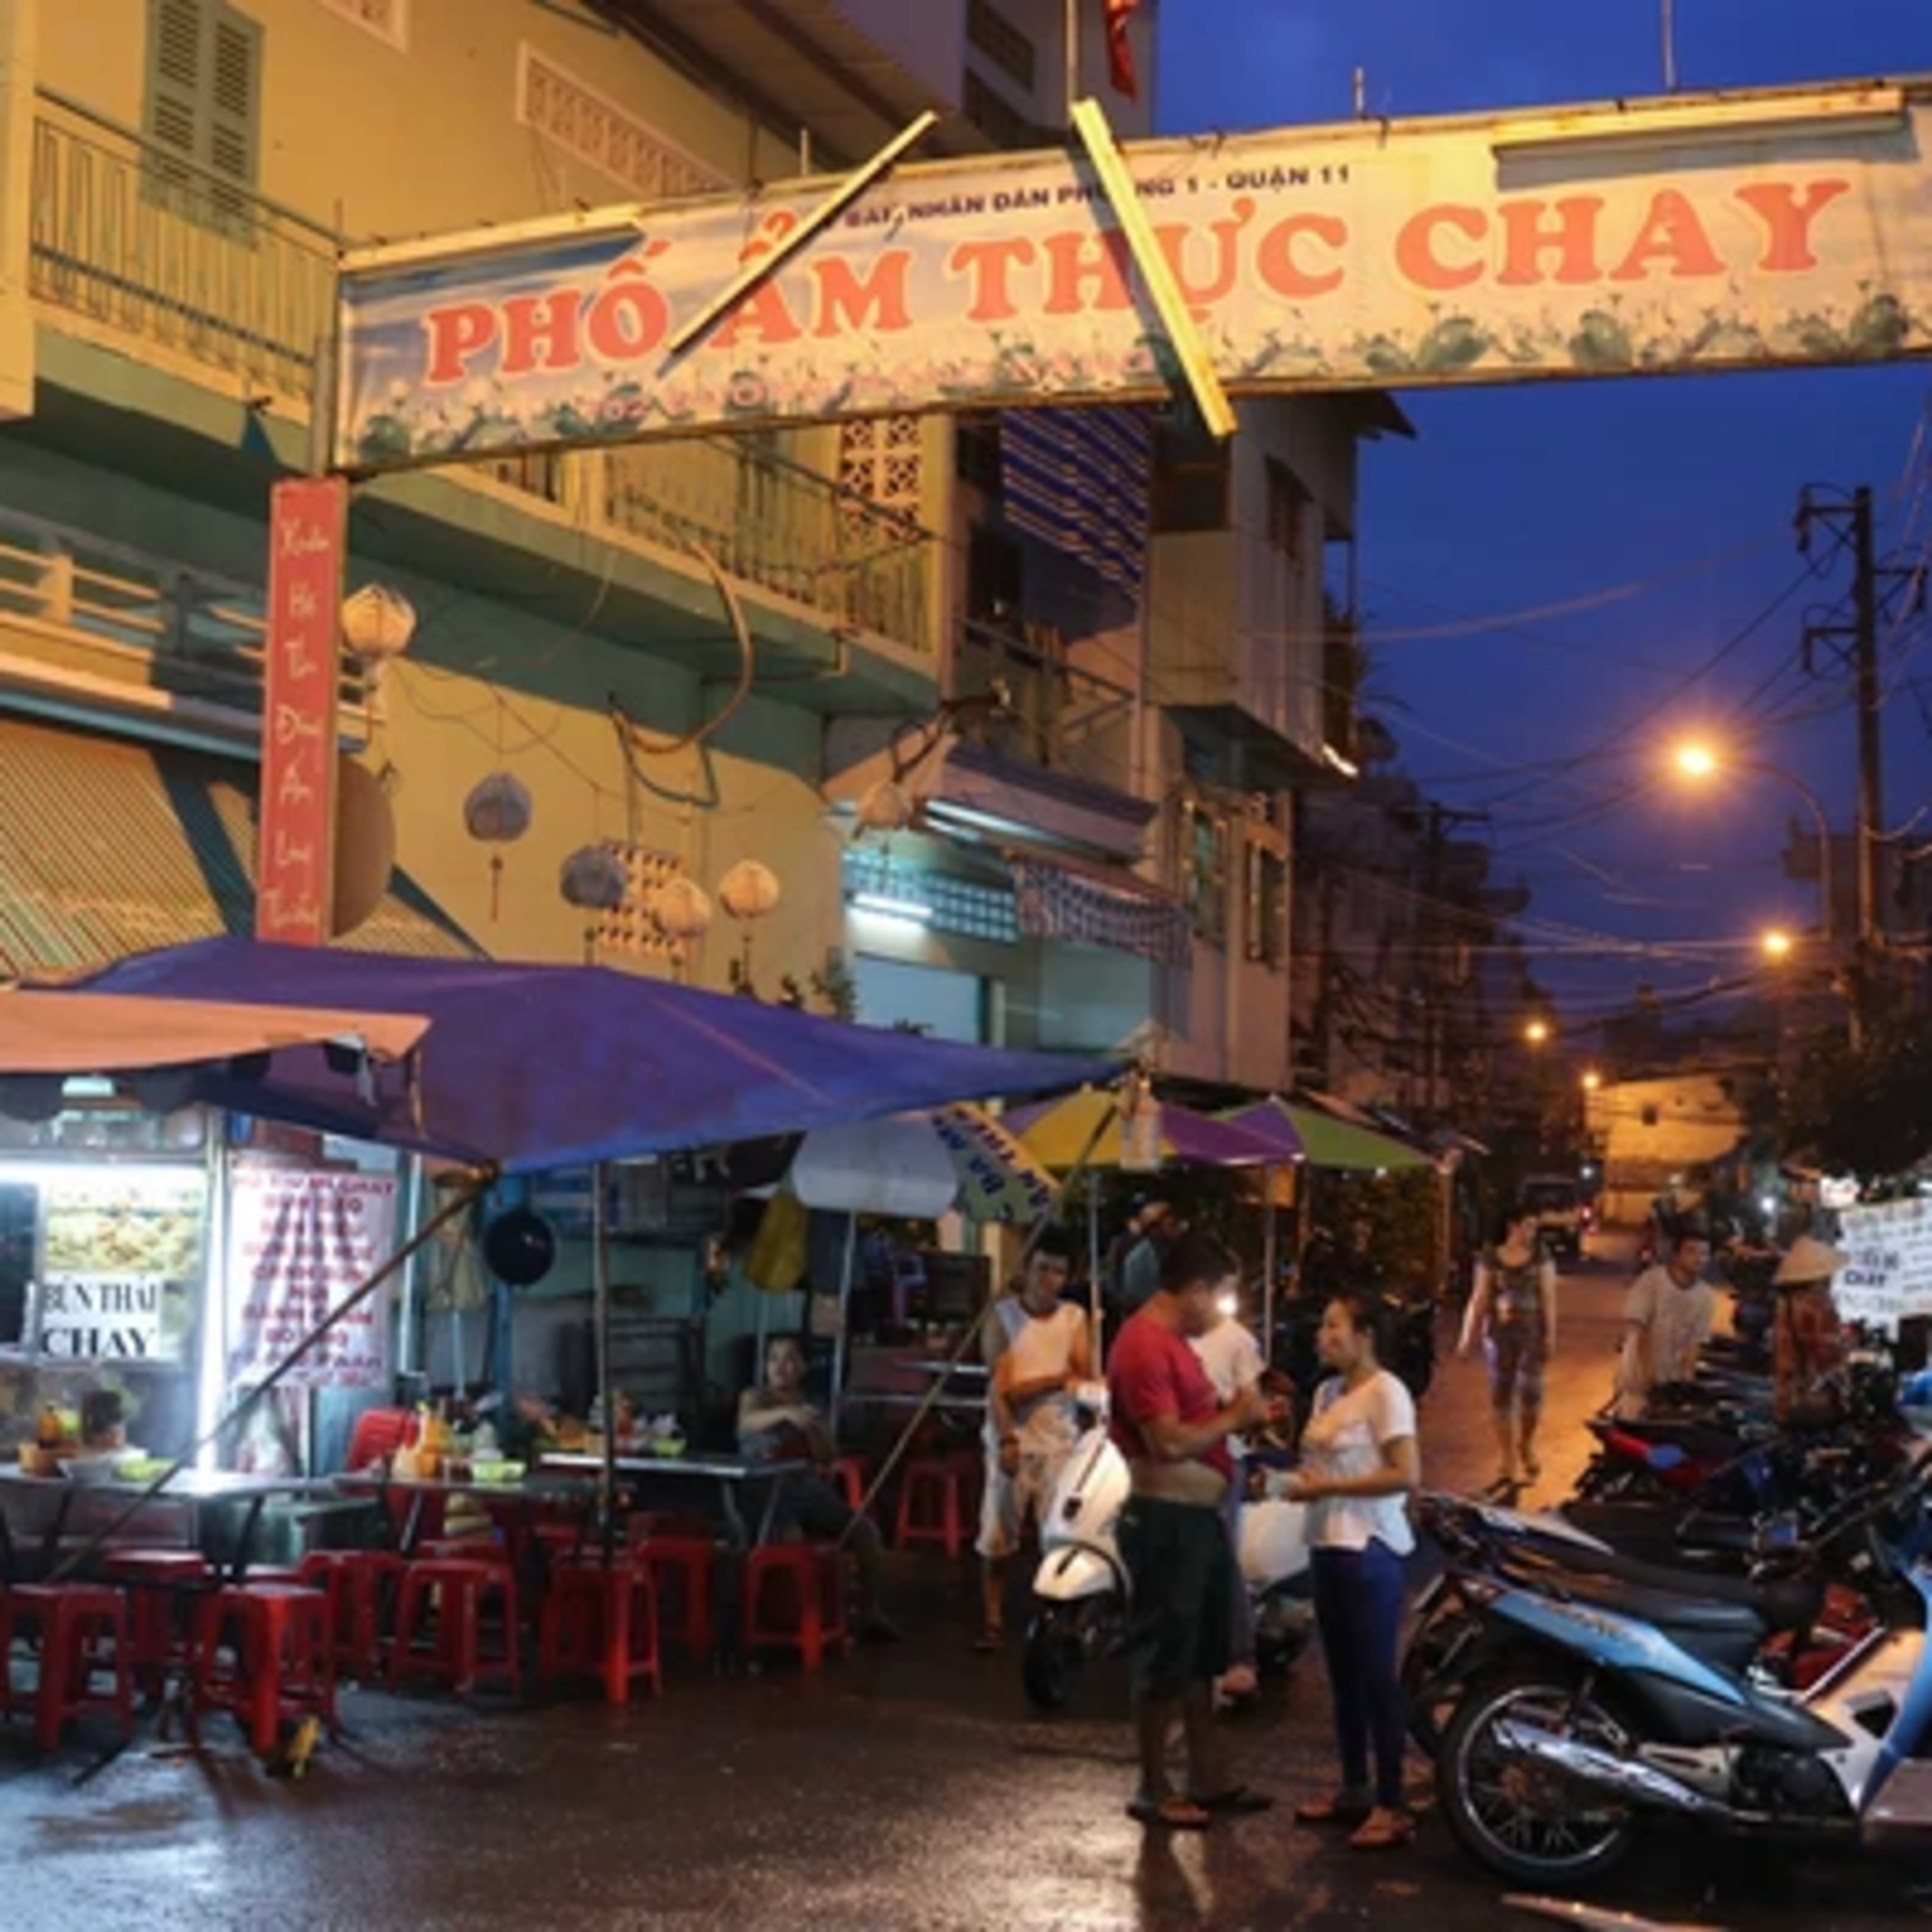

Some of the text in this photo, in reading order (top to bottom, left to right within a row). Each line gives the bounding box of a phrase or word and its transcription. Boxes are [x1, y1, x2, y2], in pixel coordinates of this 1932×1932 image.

[1058, 176, 1175, 204] PHNG
[1187, 176, 1198, 193] 1
[1227, 165, 1309, 193] QUẬN
[1321, 166, 1349, 184] 11
[424, 240, 669, 383] PHỐ
[950, 197, 1348, 322] THỰC
[1395, 180, 1851, 291] CHAY
[42, 1327, 155, 1358] CHAY
